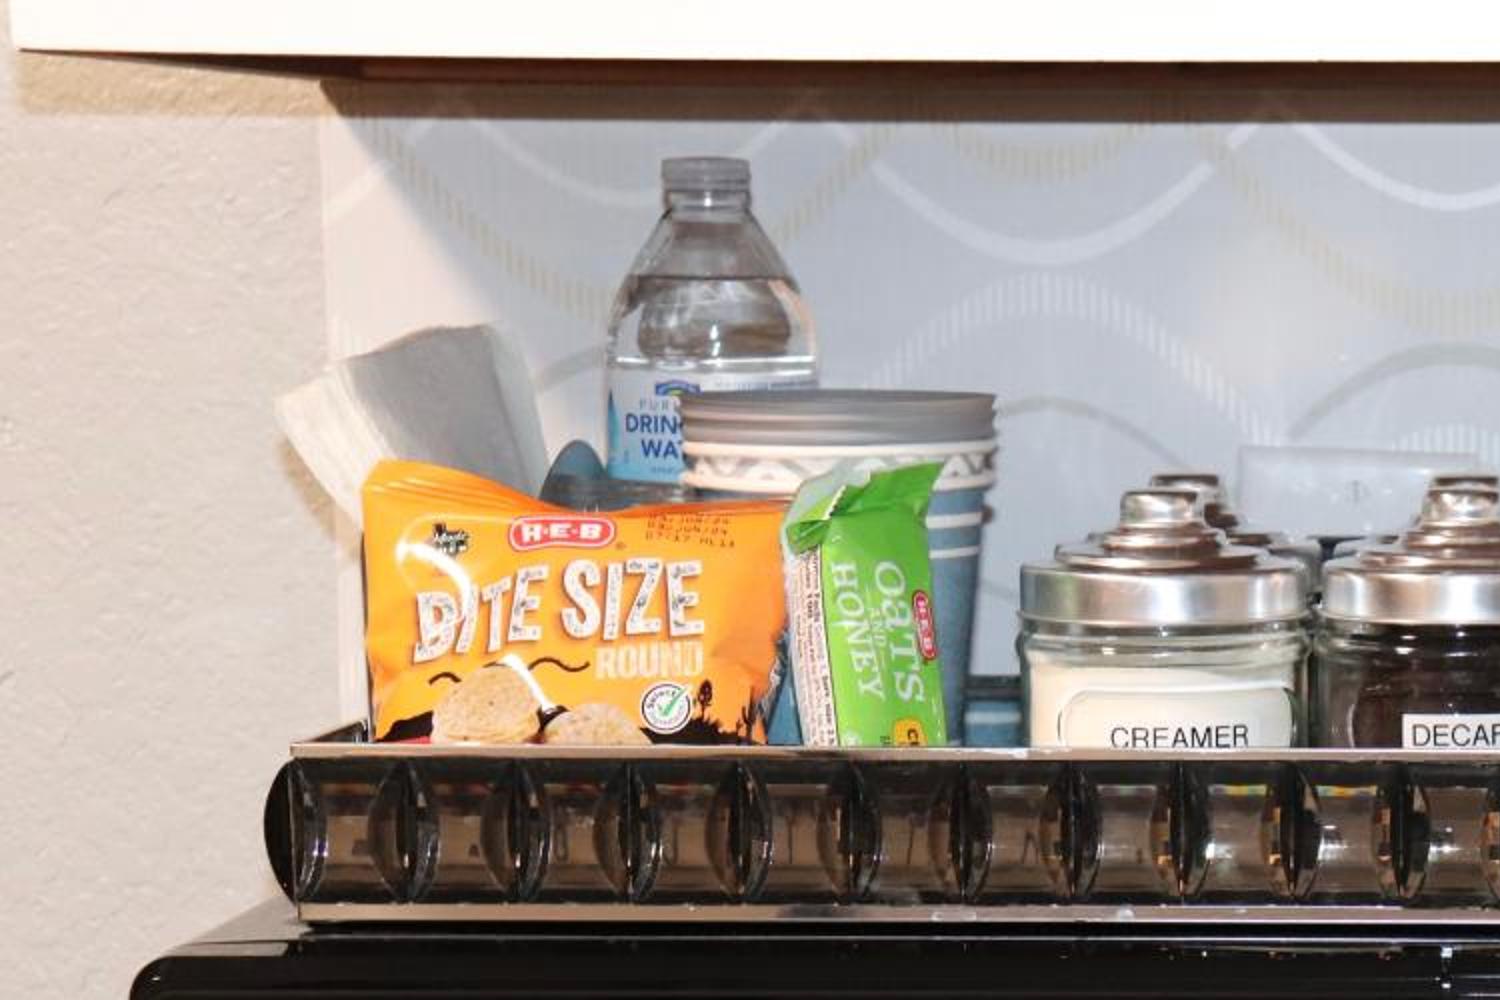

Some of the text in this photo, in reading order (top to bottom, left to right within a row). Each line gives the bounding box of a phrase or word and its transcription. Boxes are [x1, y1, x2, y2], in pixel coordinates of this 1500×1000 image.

[641, 439, 684, 458] WA
[413, 556, 705, 664] BITE SIZE
[832, 561, 886, 702] HONEY
[595, 641, 705, 680] ROUND
[1110, 724, 1249, 748] CREAMER
